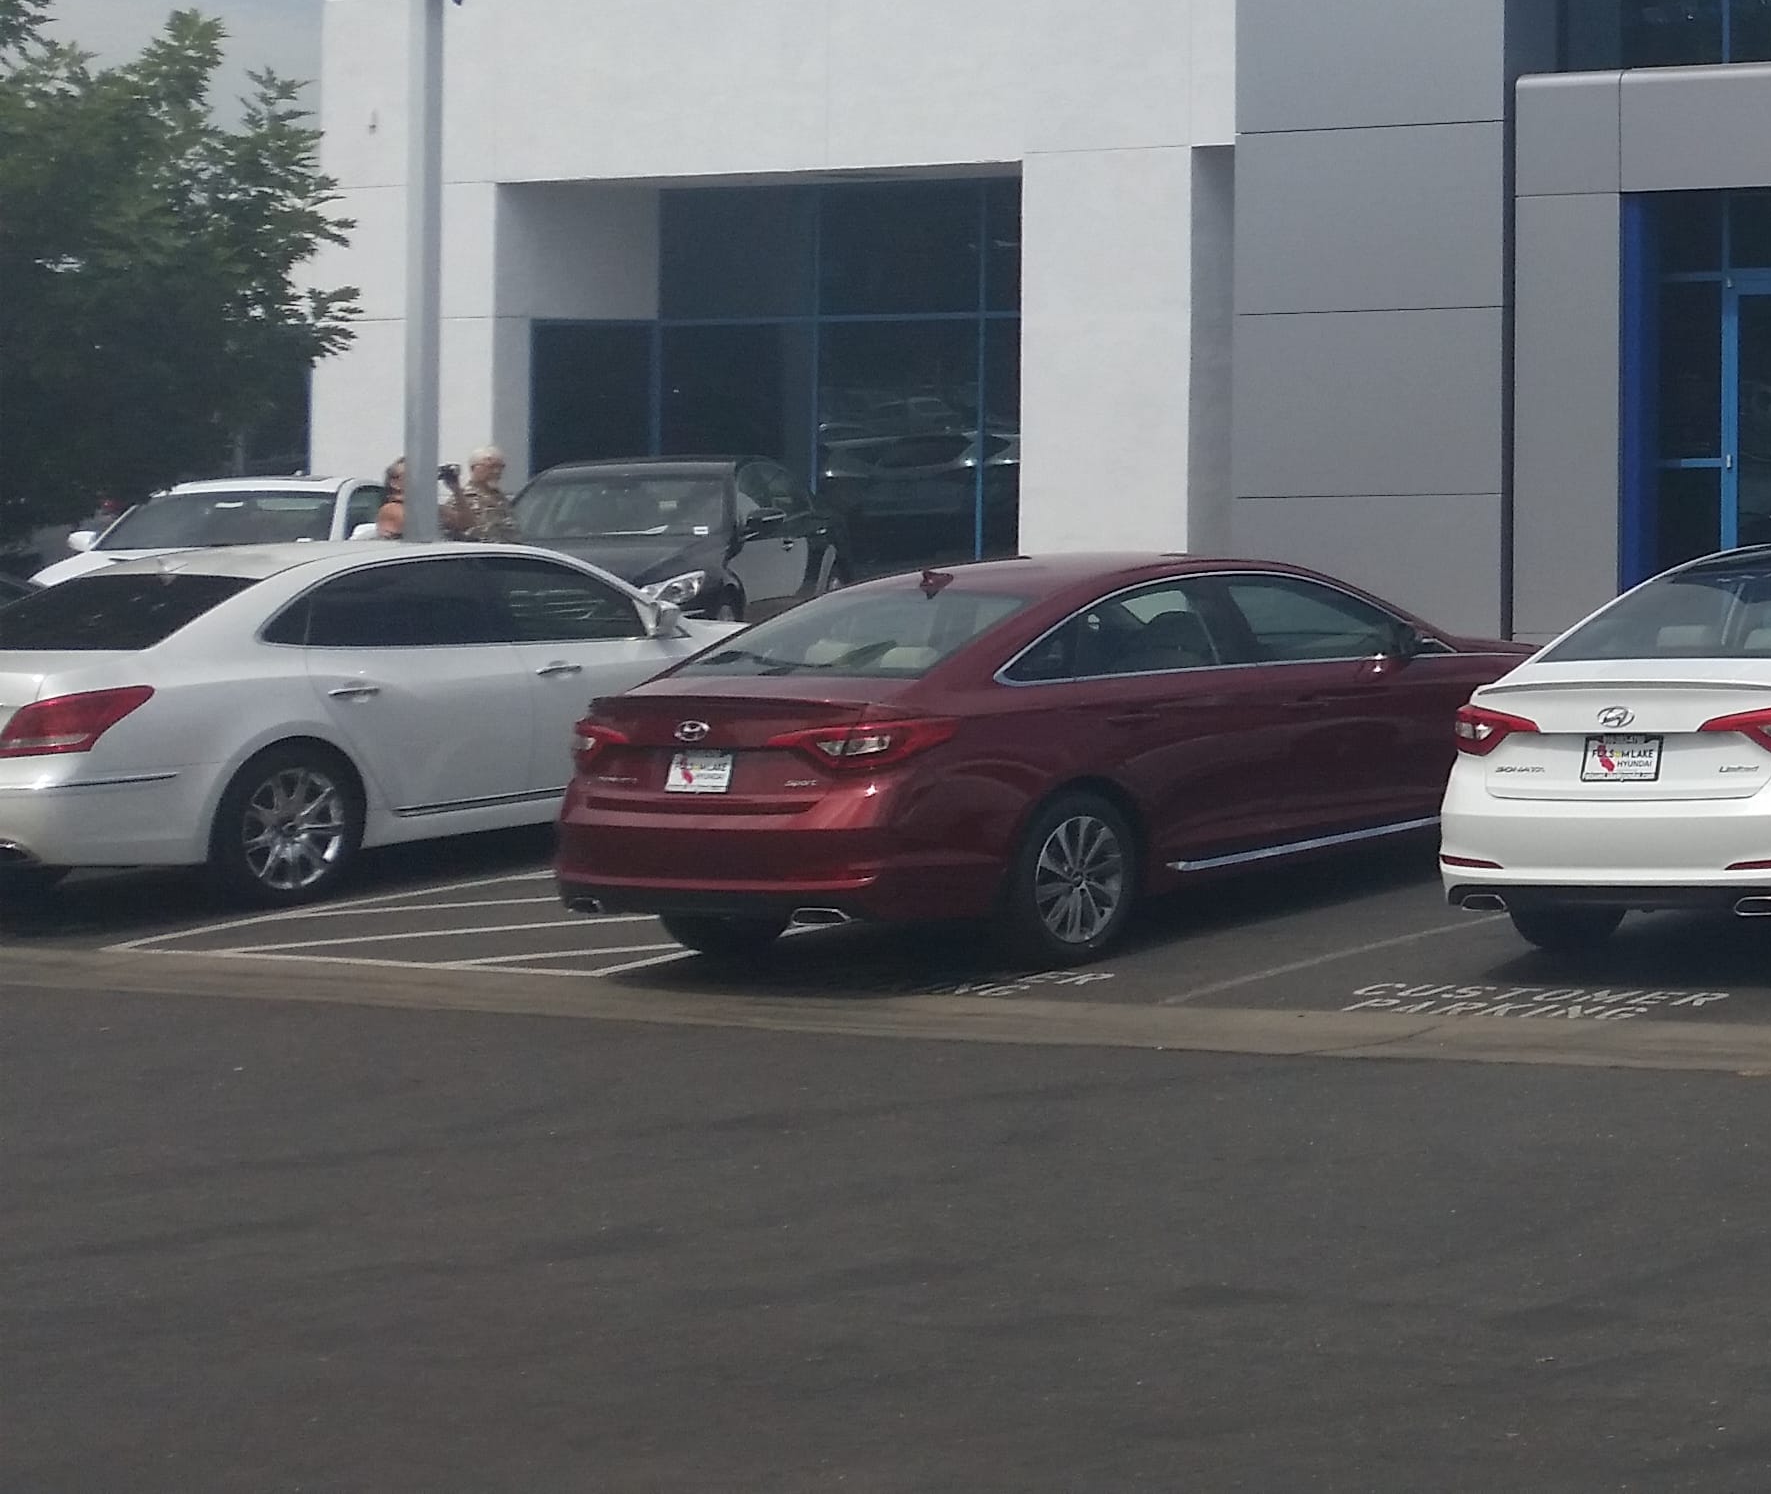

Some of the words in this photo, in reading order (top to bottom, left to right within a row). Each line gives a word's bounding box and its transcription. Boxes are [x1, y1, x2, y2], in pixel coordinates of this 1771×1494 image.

[1631, 749, 1653, 758] LAKE
[1617, 760, 1652, 768] HYUNDAI
[1353, 983, 1730, 1007] CUSTOMER
[1342, 998, 1648, 1020] PARKING
